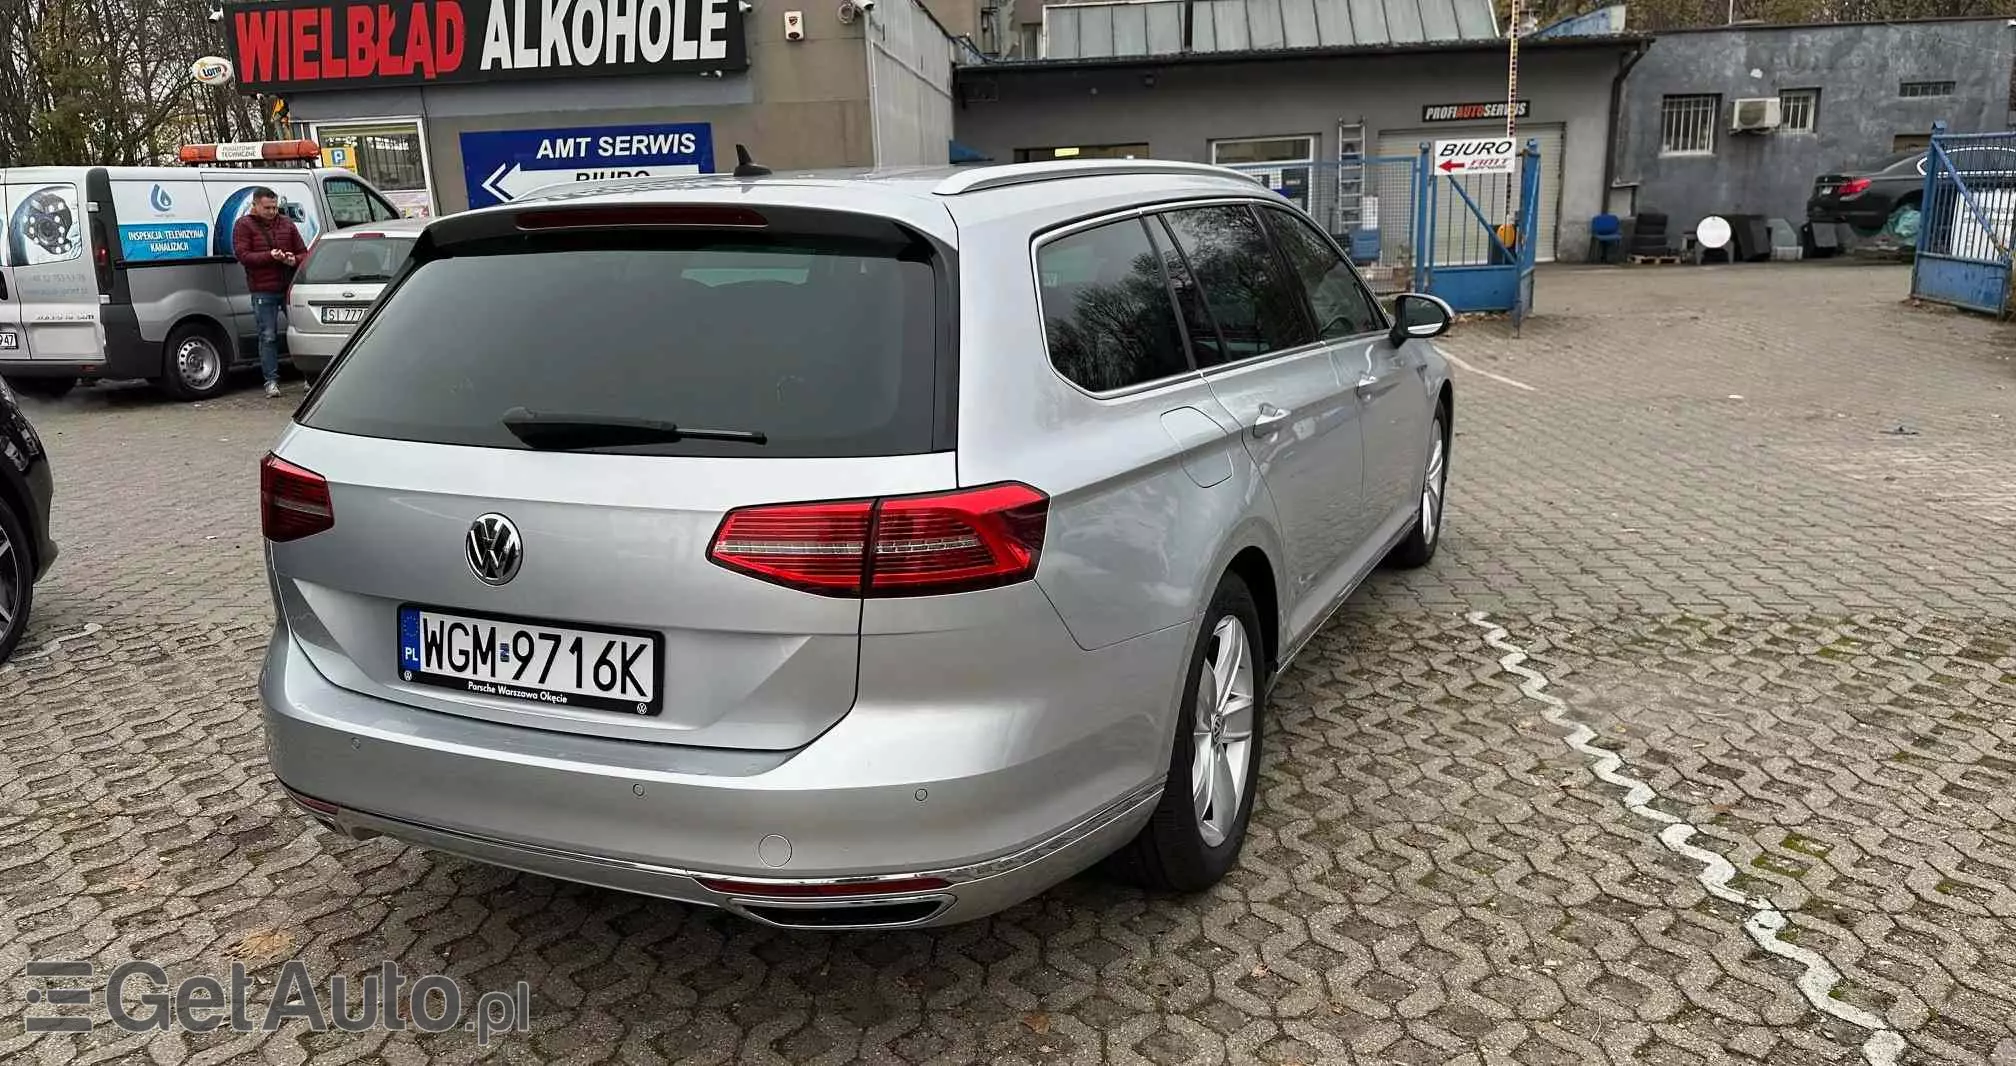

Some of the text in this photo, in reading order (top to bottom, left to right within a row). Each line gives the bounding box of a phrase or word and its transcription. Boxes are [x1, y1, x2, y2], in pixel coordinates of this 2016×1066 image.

[235, 0, 728, 83] WIELBŁĄD ALKOHOLE
[536, 133, 696, 159] AMT SERWIS
[1440, 141, 1513, 157] BIURO
[345, 309, 369, 321] 777
[405, 646, 419, 662] PL
[423, 617, 650, 697] WGM 9716K
[497, 685, 538, 700] Warszawa
[539, 691, 568, 704] Okęcie
